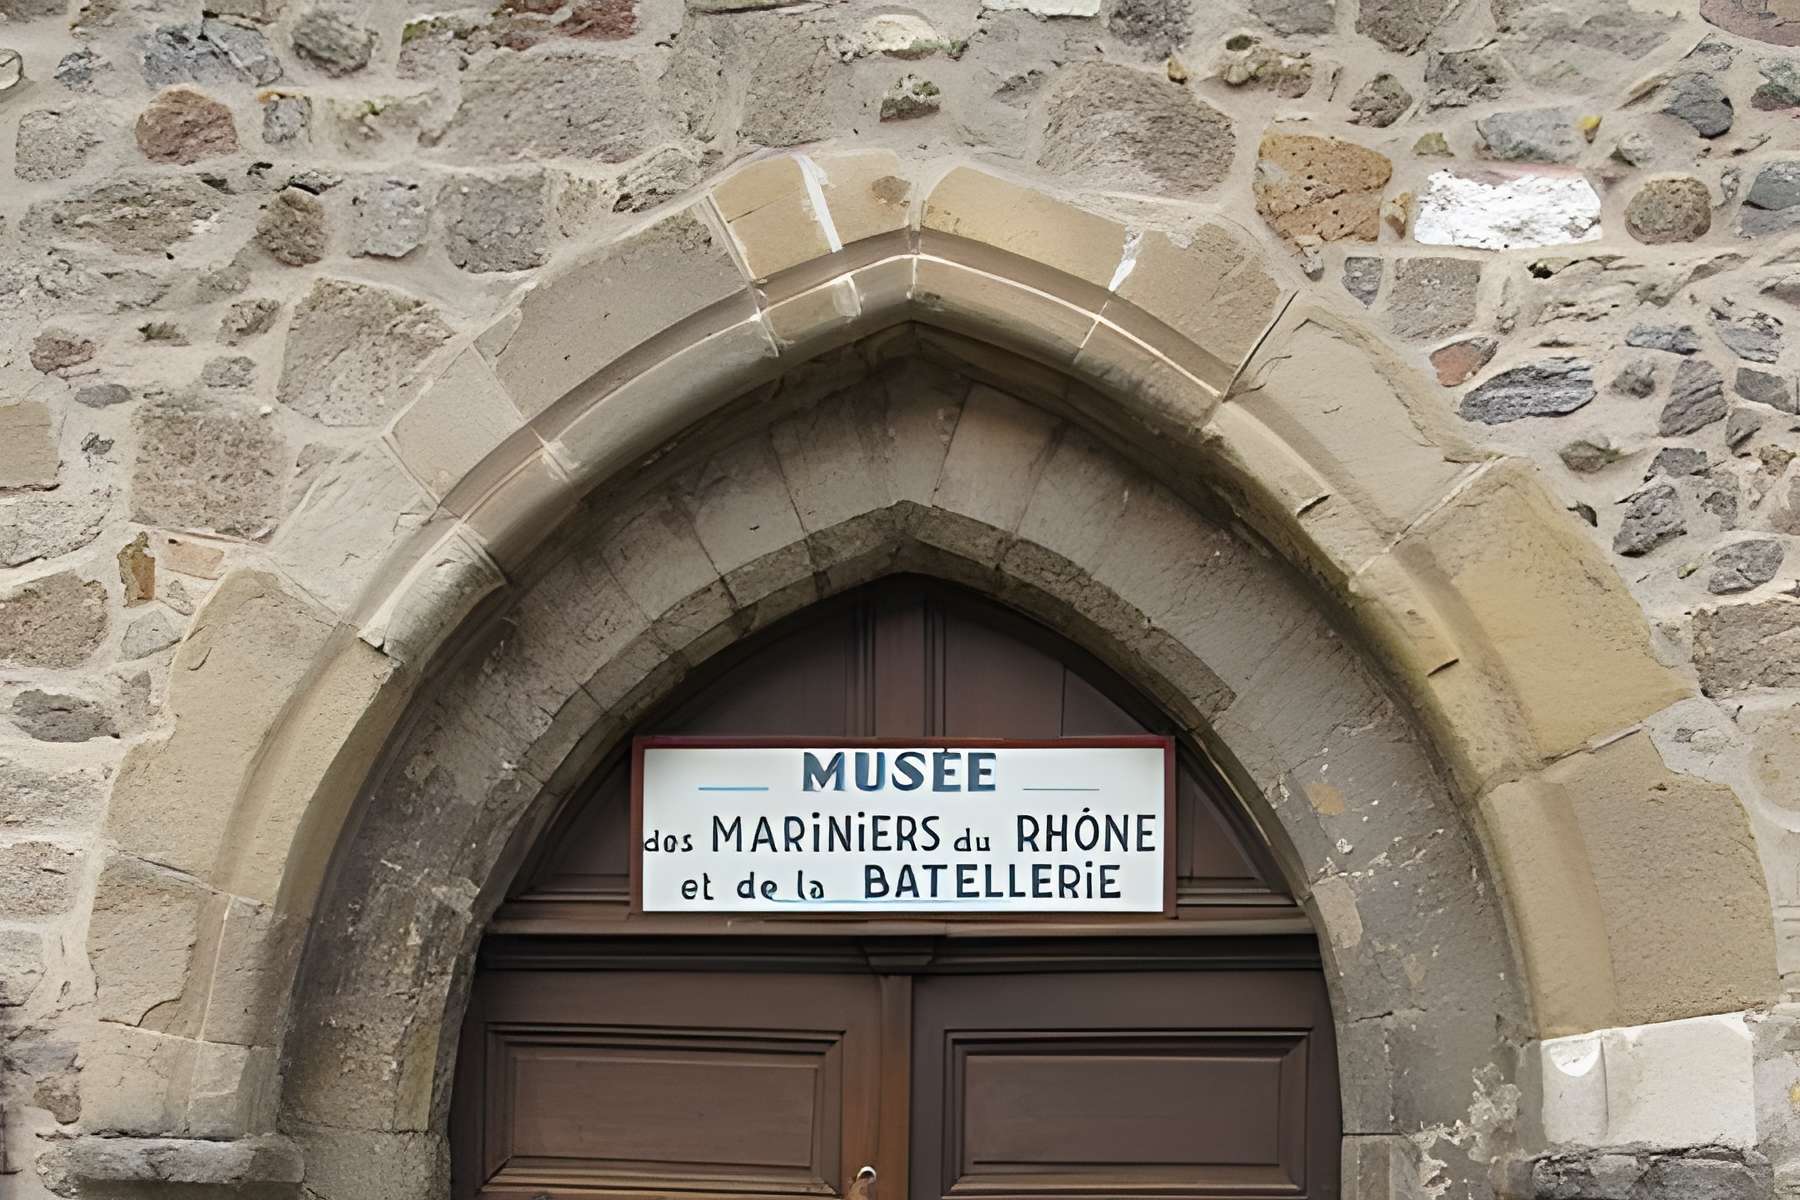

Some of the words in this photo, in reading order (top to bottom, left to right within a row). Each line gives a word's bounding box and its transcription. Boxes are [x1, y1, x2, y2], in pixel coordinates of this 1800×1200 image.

[953, 827, 991, 852] du
[681, 872, 714, 901] et
[736, 871, 778, 901] de
[797, 869, 825, 901] la
